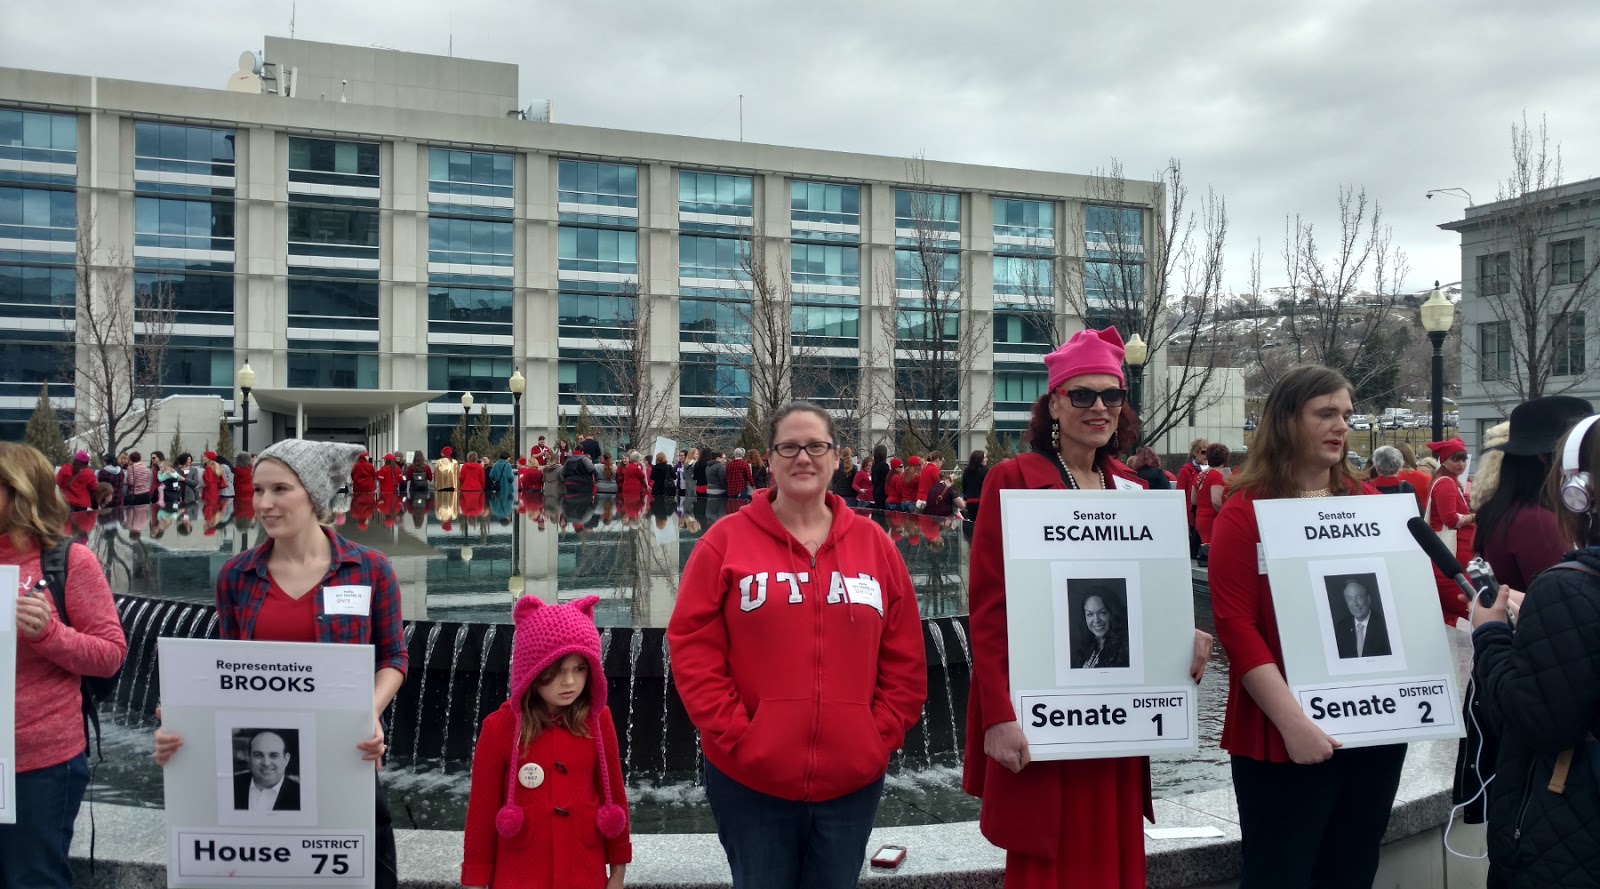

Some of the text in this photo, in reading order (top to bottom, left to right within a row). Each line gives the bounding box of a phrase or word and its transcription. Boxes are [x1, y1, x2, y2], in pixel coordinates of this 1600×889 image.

[1073, 510, 1117, 520] Senator
[1318, 511, 1356, 521] Senator
[1043, 525, 1153, 541] ESCAMILLA
[1304, 522, 1381, 540] DABAKIS
[216, 659, 313, 673] Representative
[220, 674, 316, 693] BROOKS
[1399, 685, 1444, 698] DISTRICT
[1133, 697, 1183, 708] DISTRICT
[1310, 694, 1397, 720] Senate
[1031, 703, 1127, 728] Senate
[1417, 701, 1434, 723] 2
[1151, 713, 1163, 736] 1
[194, 840, 291, 862] House
[302, 839, 359, 849] DISTRICT
[311, 854, 349, 875] 75
